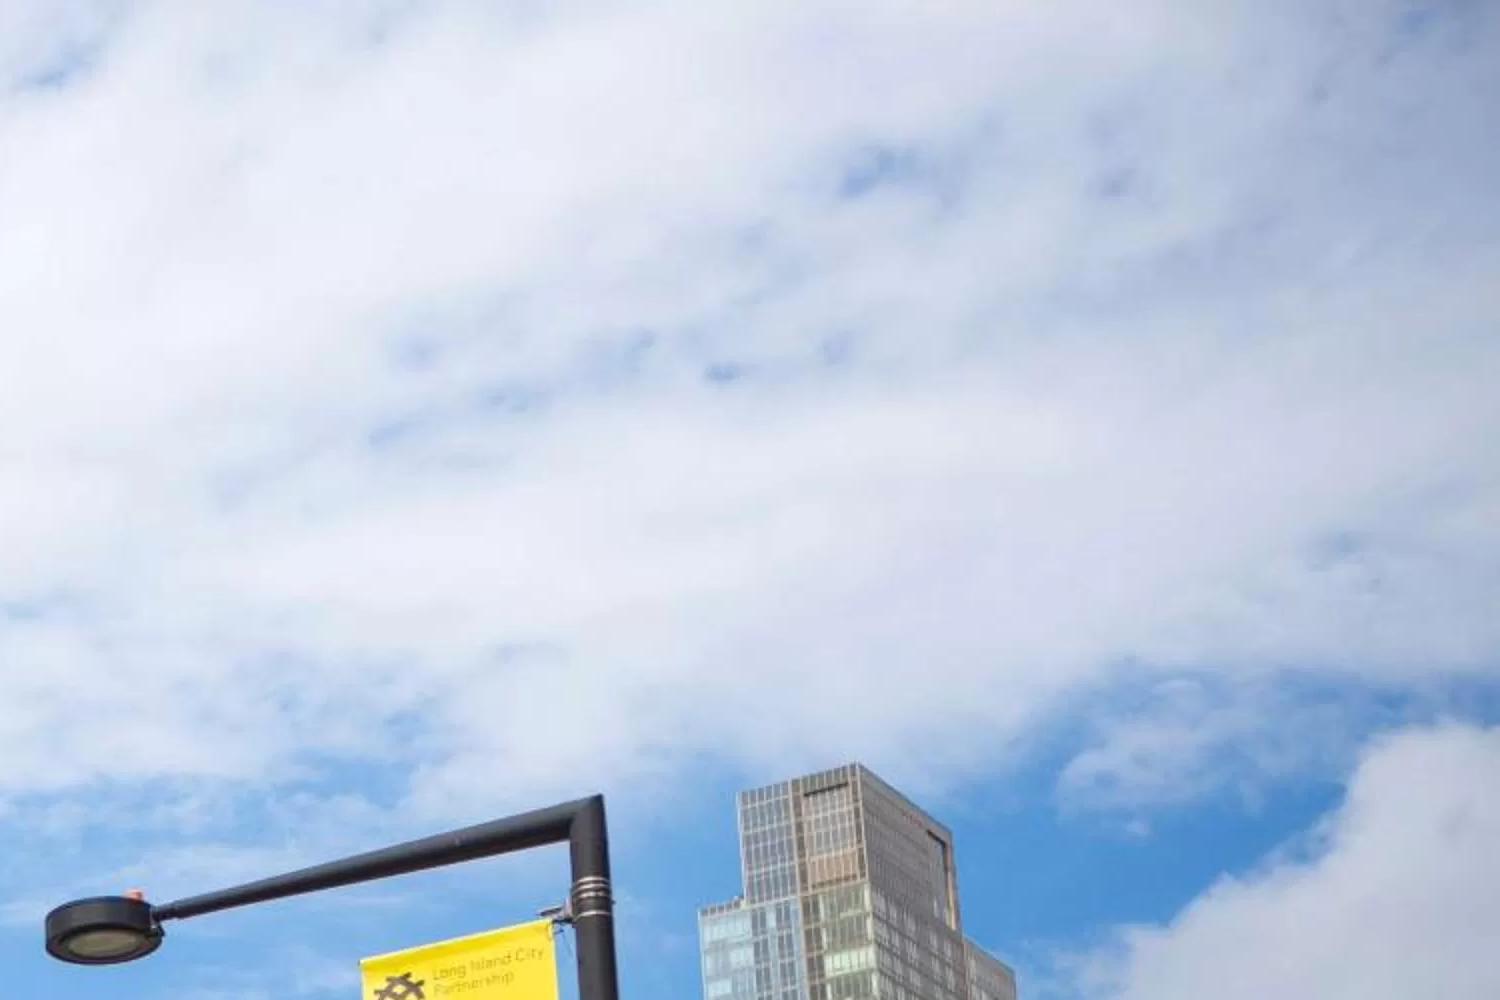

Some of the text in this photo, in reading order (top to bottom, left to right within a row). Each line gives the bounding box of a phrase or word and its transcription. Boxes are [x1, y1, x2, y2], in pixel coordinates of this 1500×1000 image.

[432, 947, 544, 981] Long Island City
[434, 972, 514, 995] Partnership
